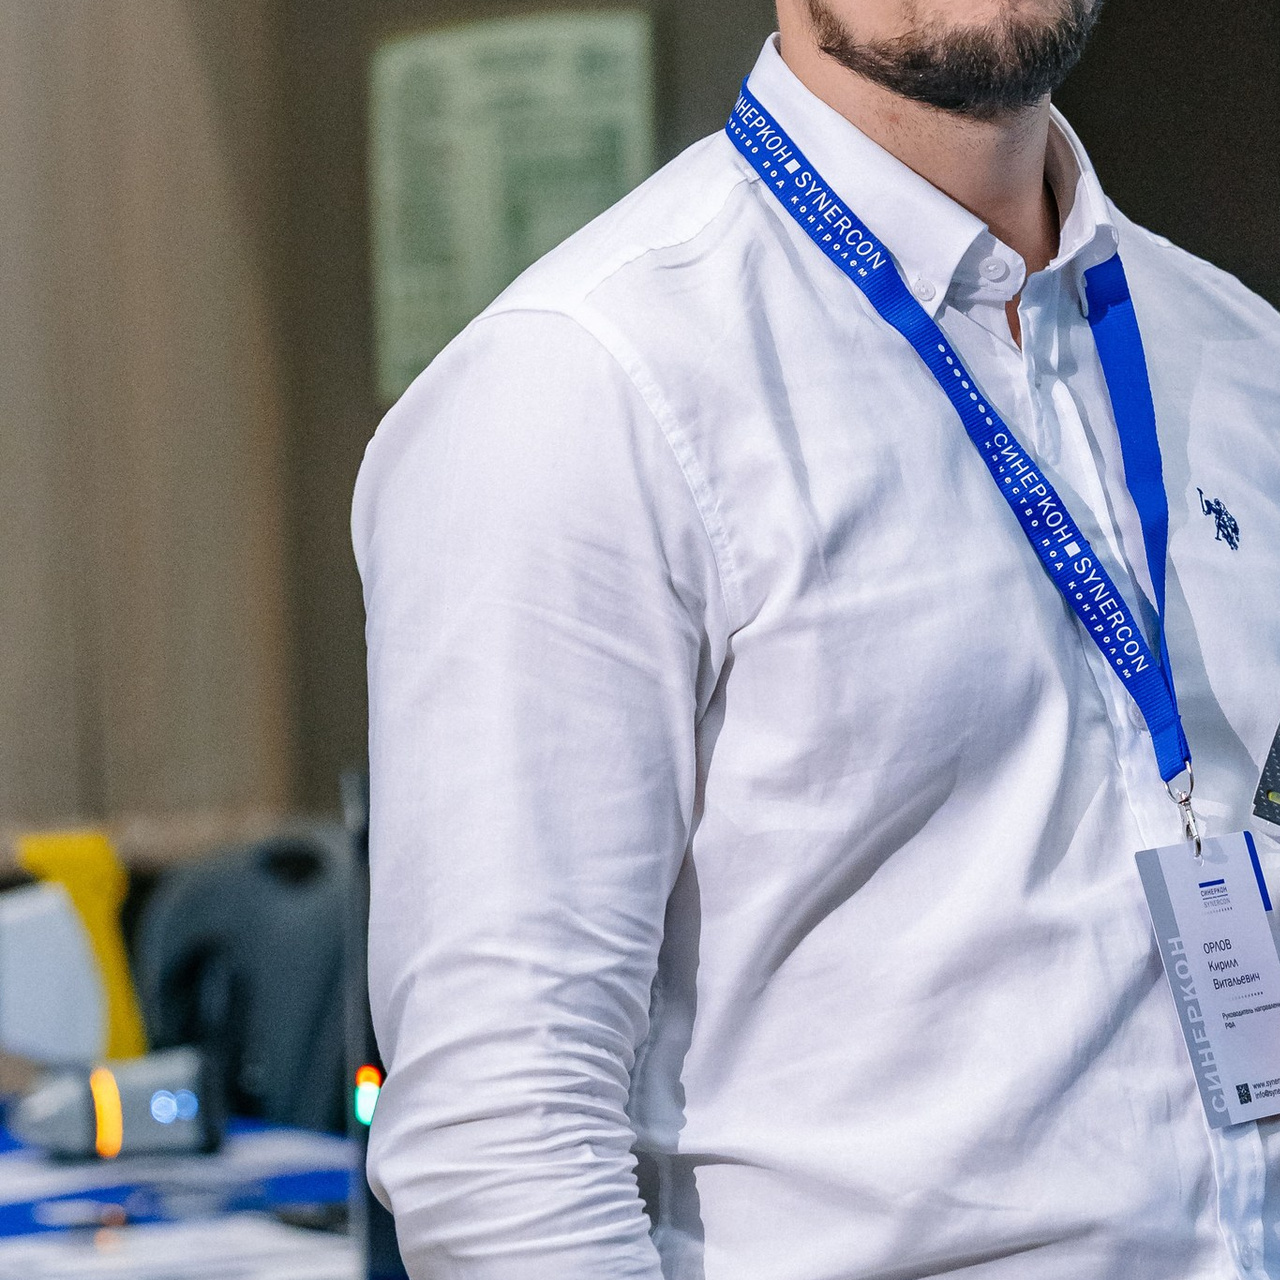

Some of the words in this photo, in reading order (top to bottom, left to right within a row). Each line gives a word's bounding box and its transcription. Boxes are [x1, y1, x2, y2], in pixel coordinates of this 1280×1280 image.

[733, 96, 793, 163] ИНЕРКОН
[794, 171, 887, 270] SYNERCON
[763, 160, 785, 189] под
[790, 193, 868, 277] контролем
[985, 441, 1040, 528] качество
[1042, 538, 1064, 571] под
[1068, 580, 1132, 679] контролем
[994, 432, 1073, 543] СИНЕРКОН
[1073, 557, 1149, 673] SYNERCON
[1203, 938, 1232, 954] ОРЛОВ
[1207, 958, 1239, 972] Кирилл
[1212, 972, 1261, 990] Витальевич
[1167, 936, 1228, 1113] СИНЕРКОН
